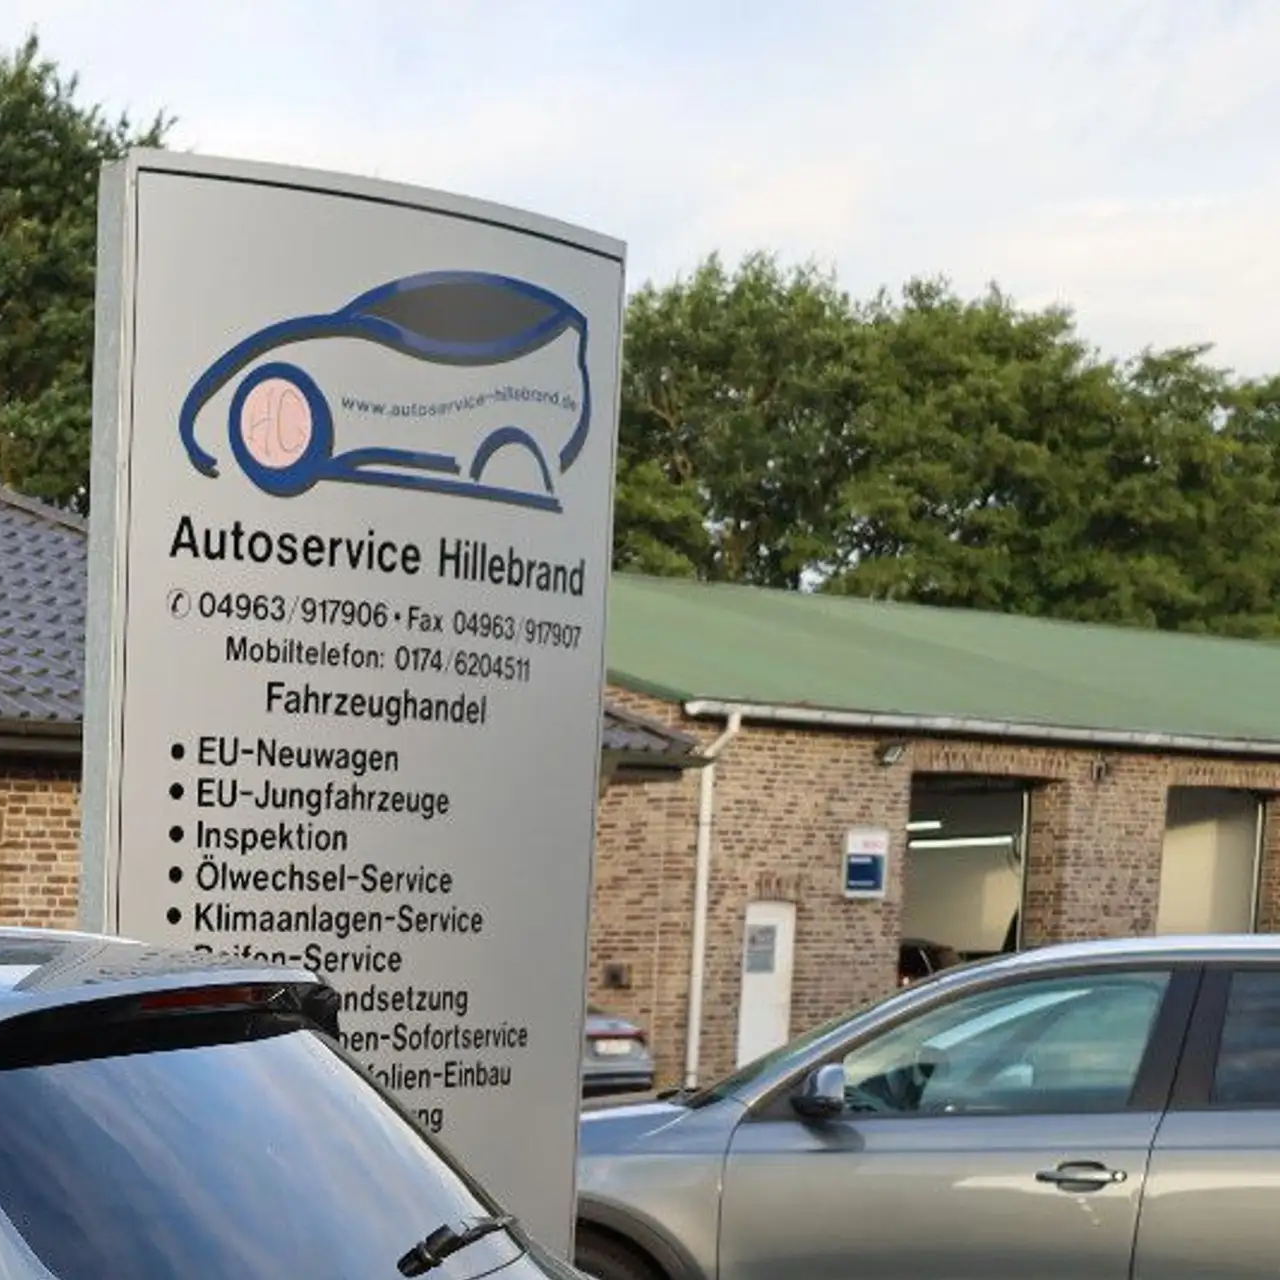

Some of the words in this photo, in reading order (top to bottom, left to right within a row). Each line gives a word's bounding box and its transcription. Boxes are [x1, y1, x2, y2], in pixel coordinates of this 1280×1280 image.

[169, 515, 422, 575] Autoservice
[438, 537, 586, 597] Hillebrand
[407, 605, 444, 633] Fax
[225, 635, 385, 668] Mobiltelefon:
[266, 681, 488, 726] Fahrzeughandel
[197, 737, 399, 776] EU-Neuwagen
[196, 778, 450, 820] EU-Jungfahrzeuge
[197, 820, 348, 855] Inspektion
[196, 855, 453, 894] Ölwechsel-Service
[194, 902, 485, 939] Klimaanlagen-Service
[337, 984, 469, 1018] ndsetzung
